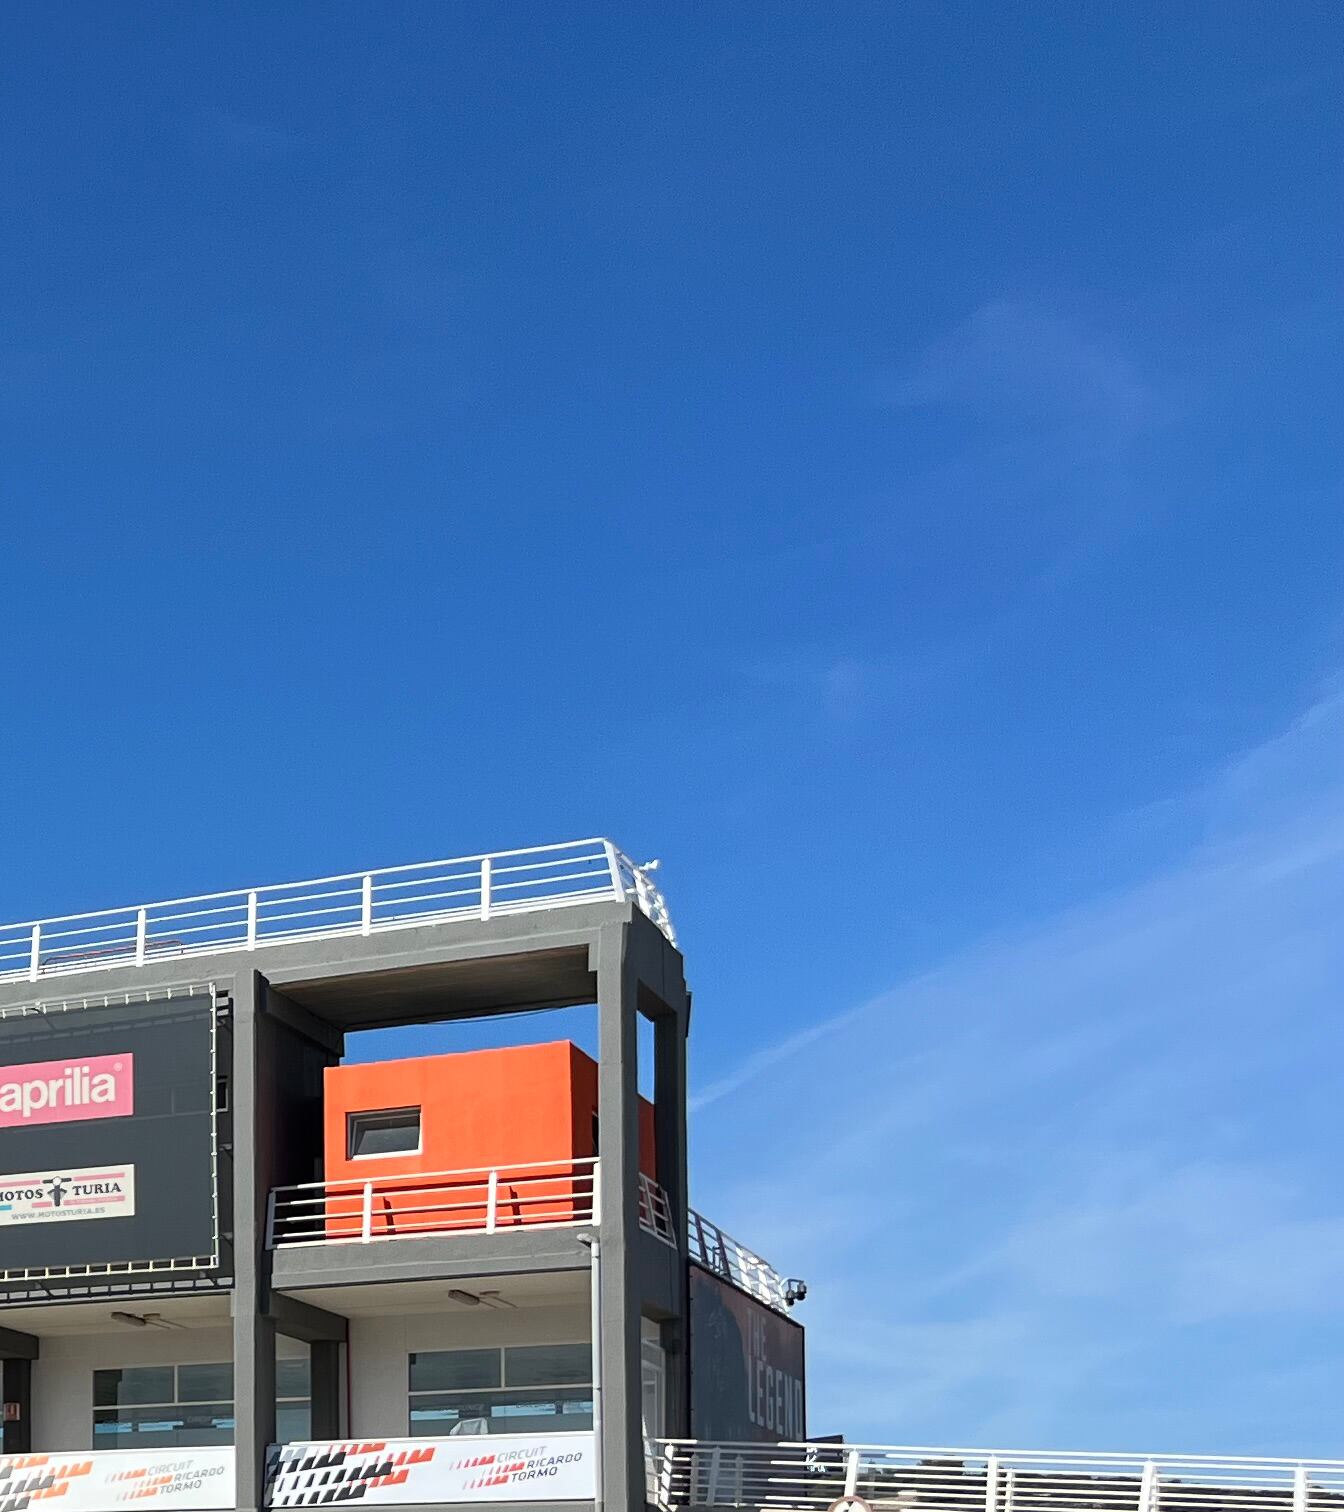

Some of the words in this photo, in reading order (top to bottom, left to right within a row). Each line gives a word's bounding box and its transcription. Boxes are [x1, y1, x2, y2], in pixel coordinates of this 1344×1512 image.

[72, 1182, 122, 1196] TURIA
[12, 1206, 106, 1221] WWW.MOTOSTURIA.ES
[747, 1357, 803, 1442] LEGEND
[497, 1445, 547, 1464] CIRCUIT
[526, 1452, 583, 1470] RICARDO
[147, 1459, 194, 1477] CIRCUIT
[173, 1465, 225, 1482] RICARDO
[512, 1466, 558, 1483] TORMO
[159, 1479, 202, 1494] TORMO
